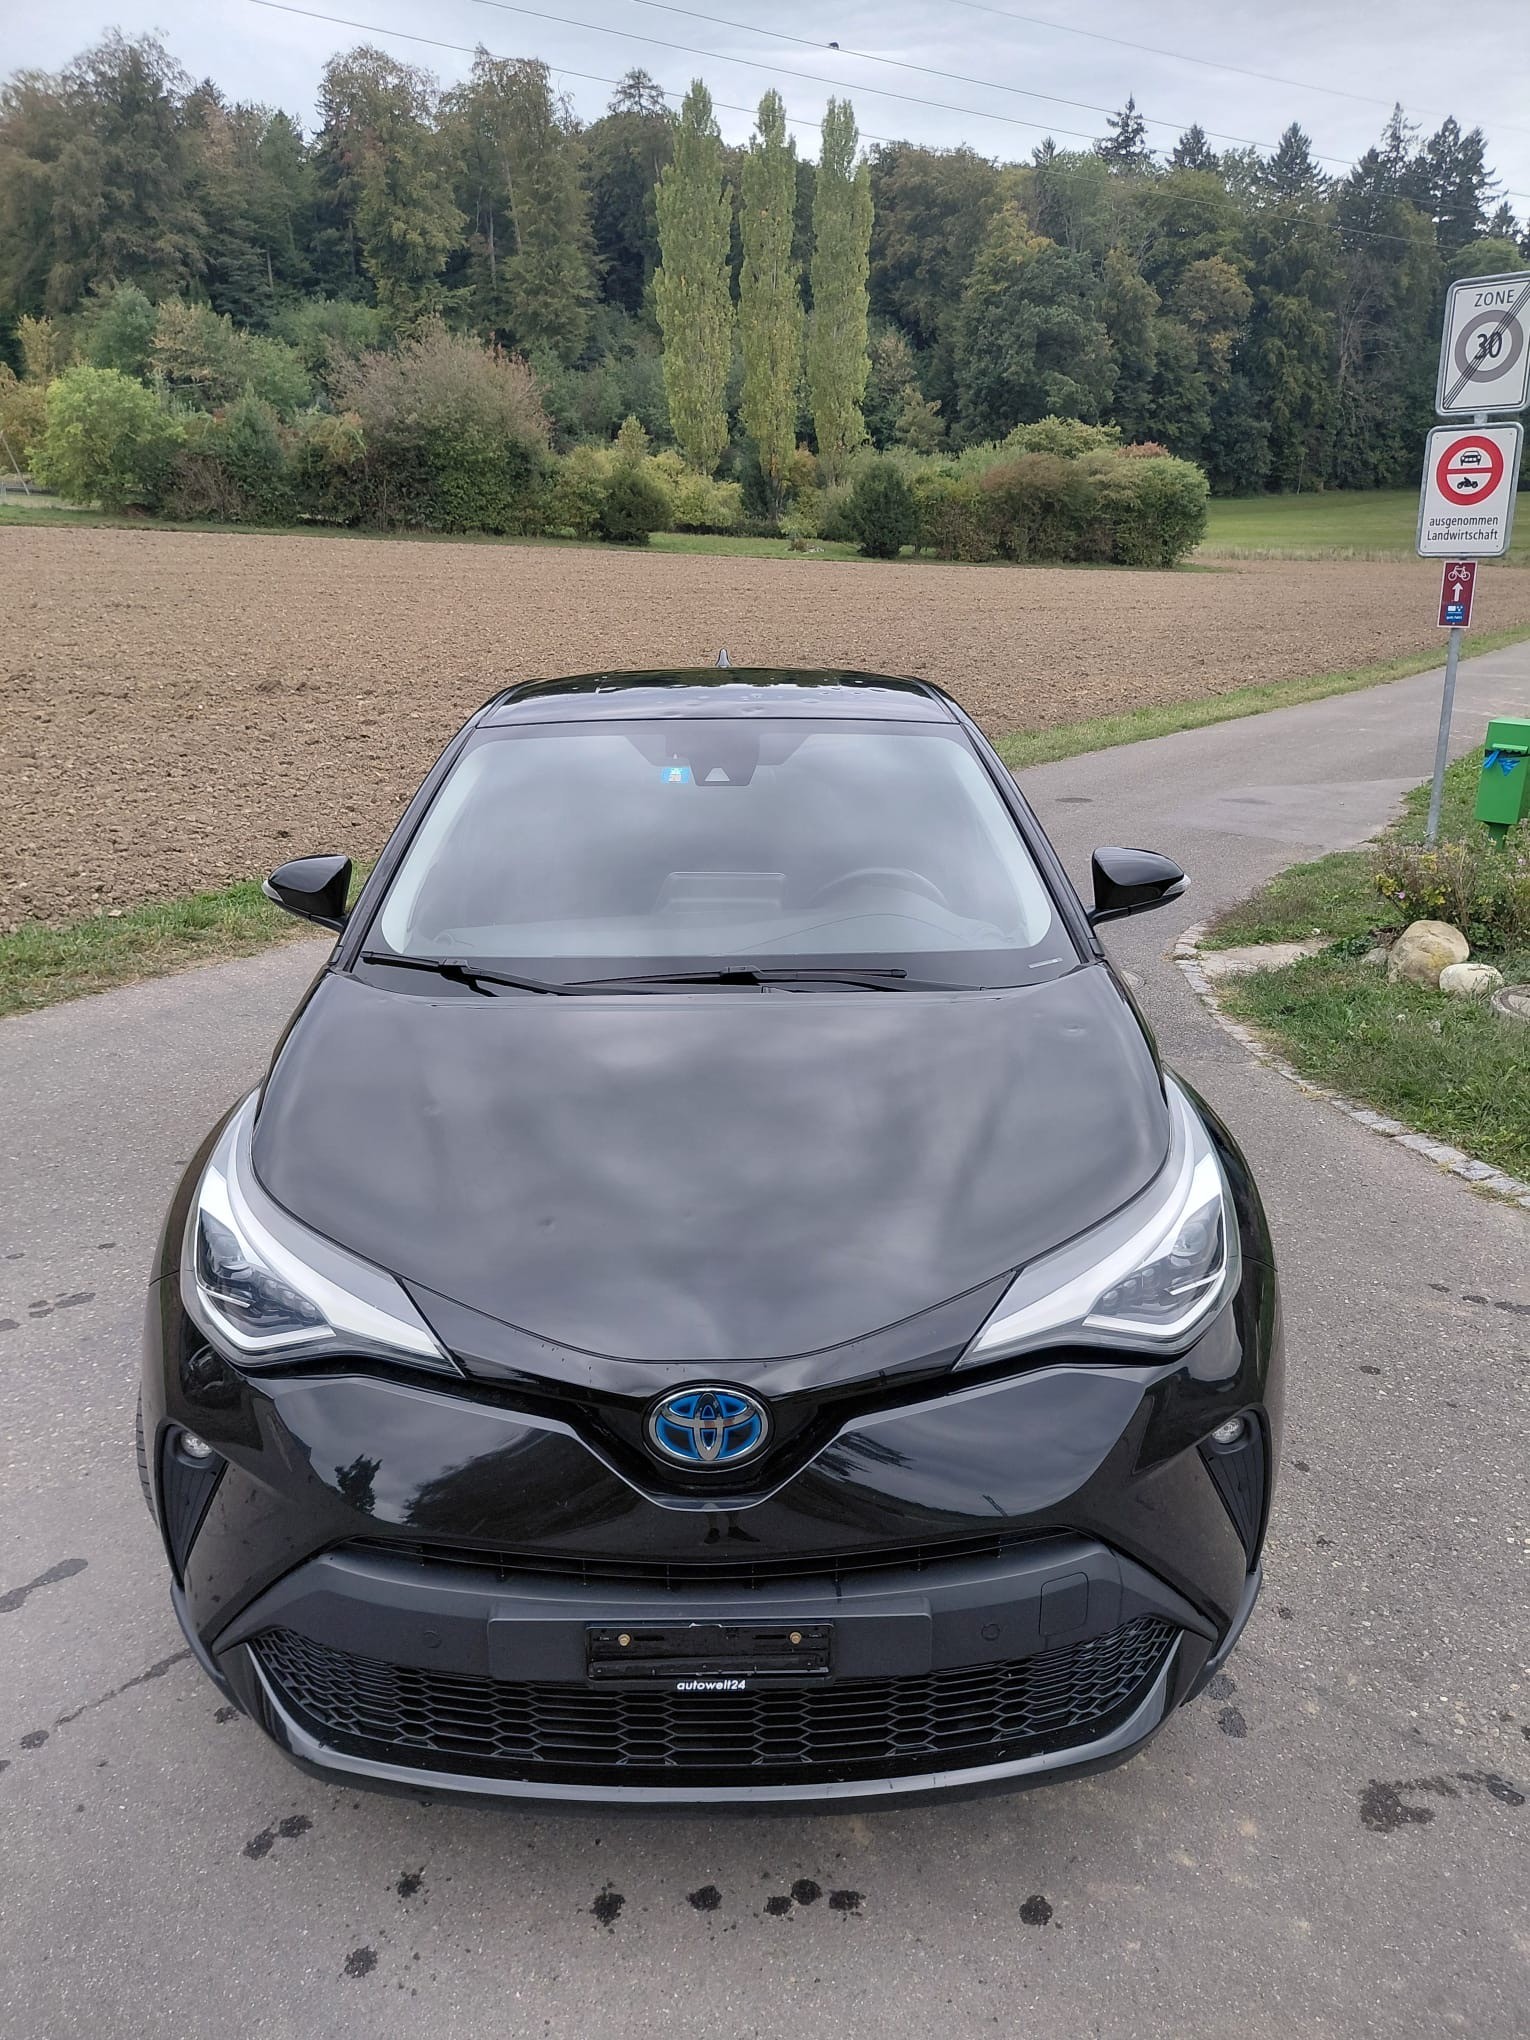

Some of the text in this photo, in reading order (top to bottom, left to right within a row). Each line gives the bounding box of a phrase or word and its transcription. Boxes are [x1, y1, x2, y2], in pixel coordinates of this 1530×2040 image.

[1474, 289, 1515, 307] ZONE
[1475, 331, 1503, 360] 30
[1429, 516, 1499, 529] ausgenommen
[1427, 528, 1498, 541] Landwirtschaft
[676, 1679, 746, 1690] autowelt24
